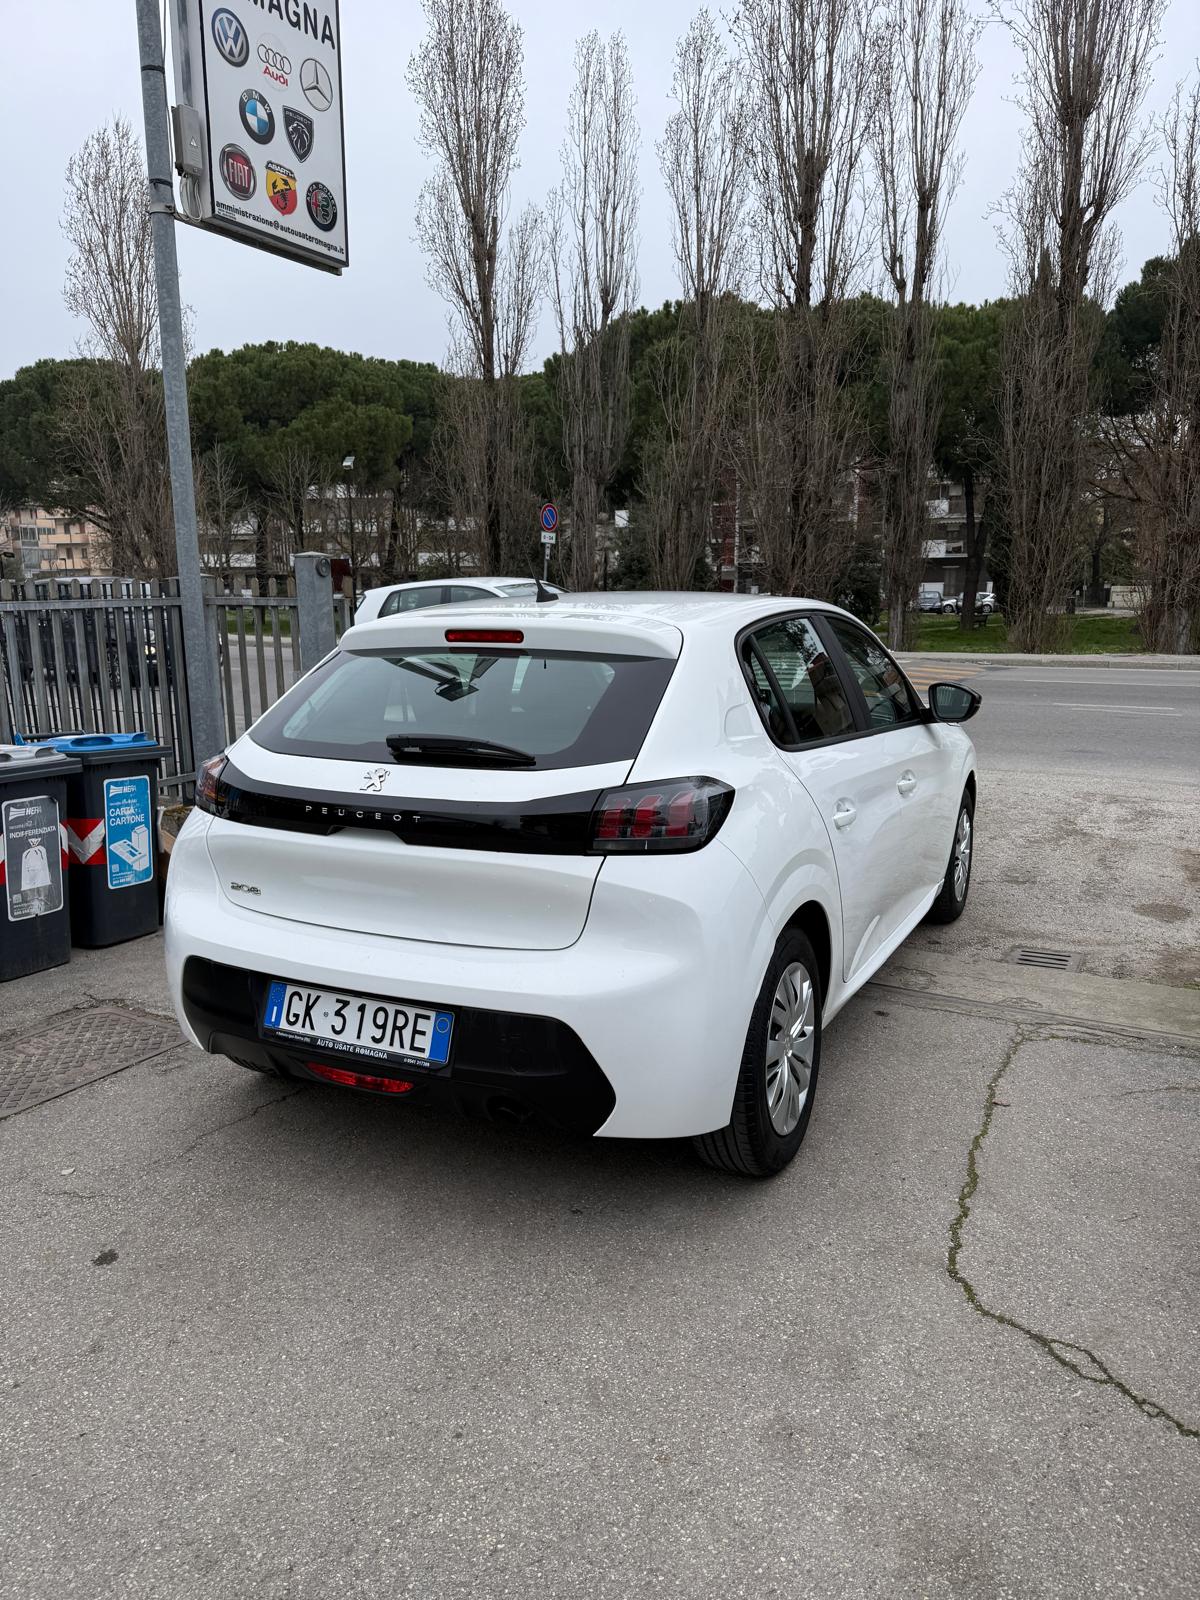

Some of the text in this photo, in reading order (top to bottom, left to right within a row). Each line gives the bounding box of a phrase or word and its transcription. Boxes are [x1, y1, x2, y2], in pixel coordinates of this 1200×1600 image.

[248, 0, 336, 50] AGNA
[242, 91, 271, 113] BMW
[285, 110, 312, 125] PEUGEOT
[228, 158, 250, 188] FIAT
[267, 162, 295, 178] ABARTH
[307, 183, 337, 213] ALFA ROMEO
[215, 200, 345, 255] amministrazione@autousateromagna.it
[25, 805, 42, 816] HERA
[109, 806, 134, 817] CARTA
[305, 805, 421, 824] PEUGEOT
[109, 814, 145, 827] CARTONE
[9, 825, 57, 839] INDIFFERENZIATA
[230, 881, 262, 896] 208
[285, 990, 432, 1054] GK 319RE
[316, 1038, 388, 1060] AUTO USATE ROMAGNA
